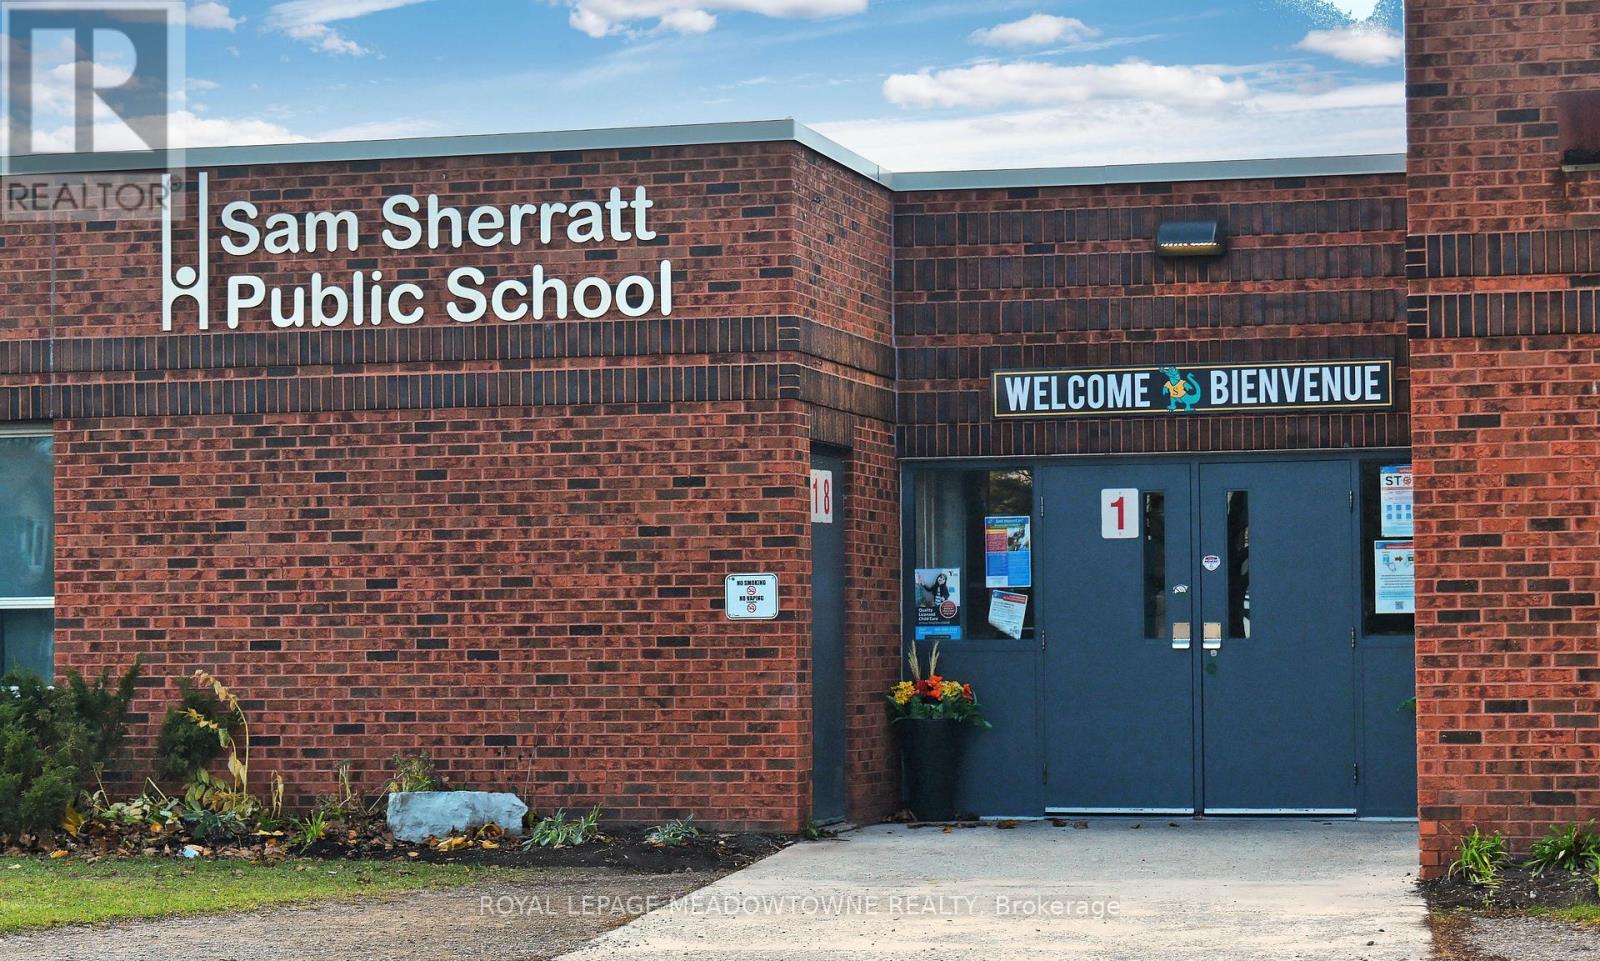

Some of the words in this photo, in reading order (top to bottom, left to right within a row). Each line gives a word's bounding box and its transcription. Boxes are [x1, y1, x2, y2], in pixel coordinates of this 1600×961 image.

[220, 200, 359, 256] Sam
[381, 185, 656, 250] Sherratt
[227, 270, 424, 330] Public
[446, 259, 671, 324] School
[1004, 373, 1151, 411] WELCOME
[1210, 365, 1382, 405] BIENVENUE
[812, 478, 830, 514] 18
[1110, 496, 1125, 530] 1
